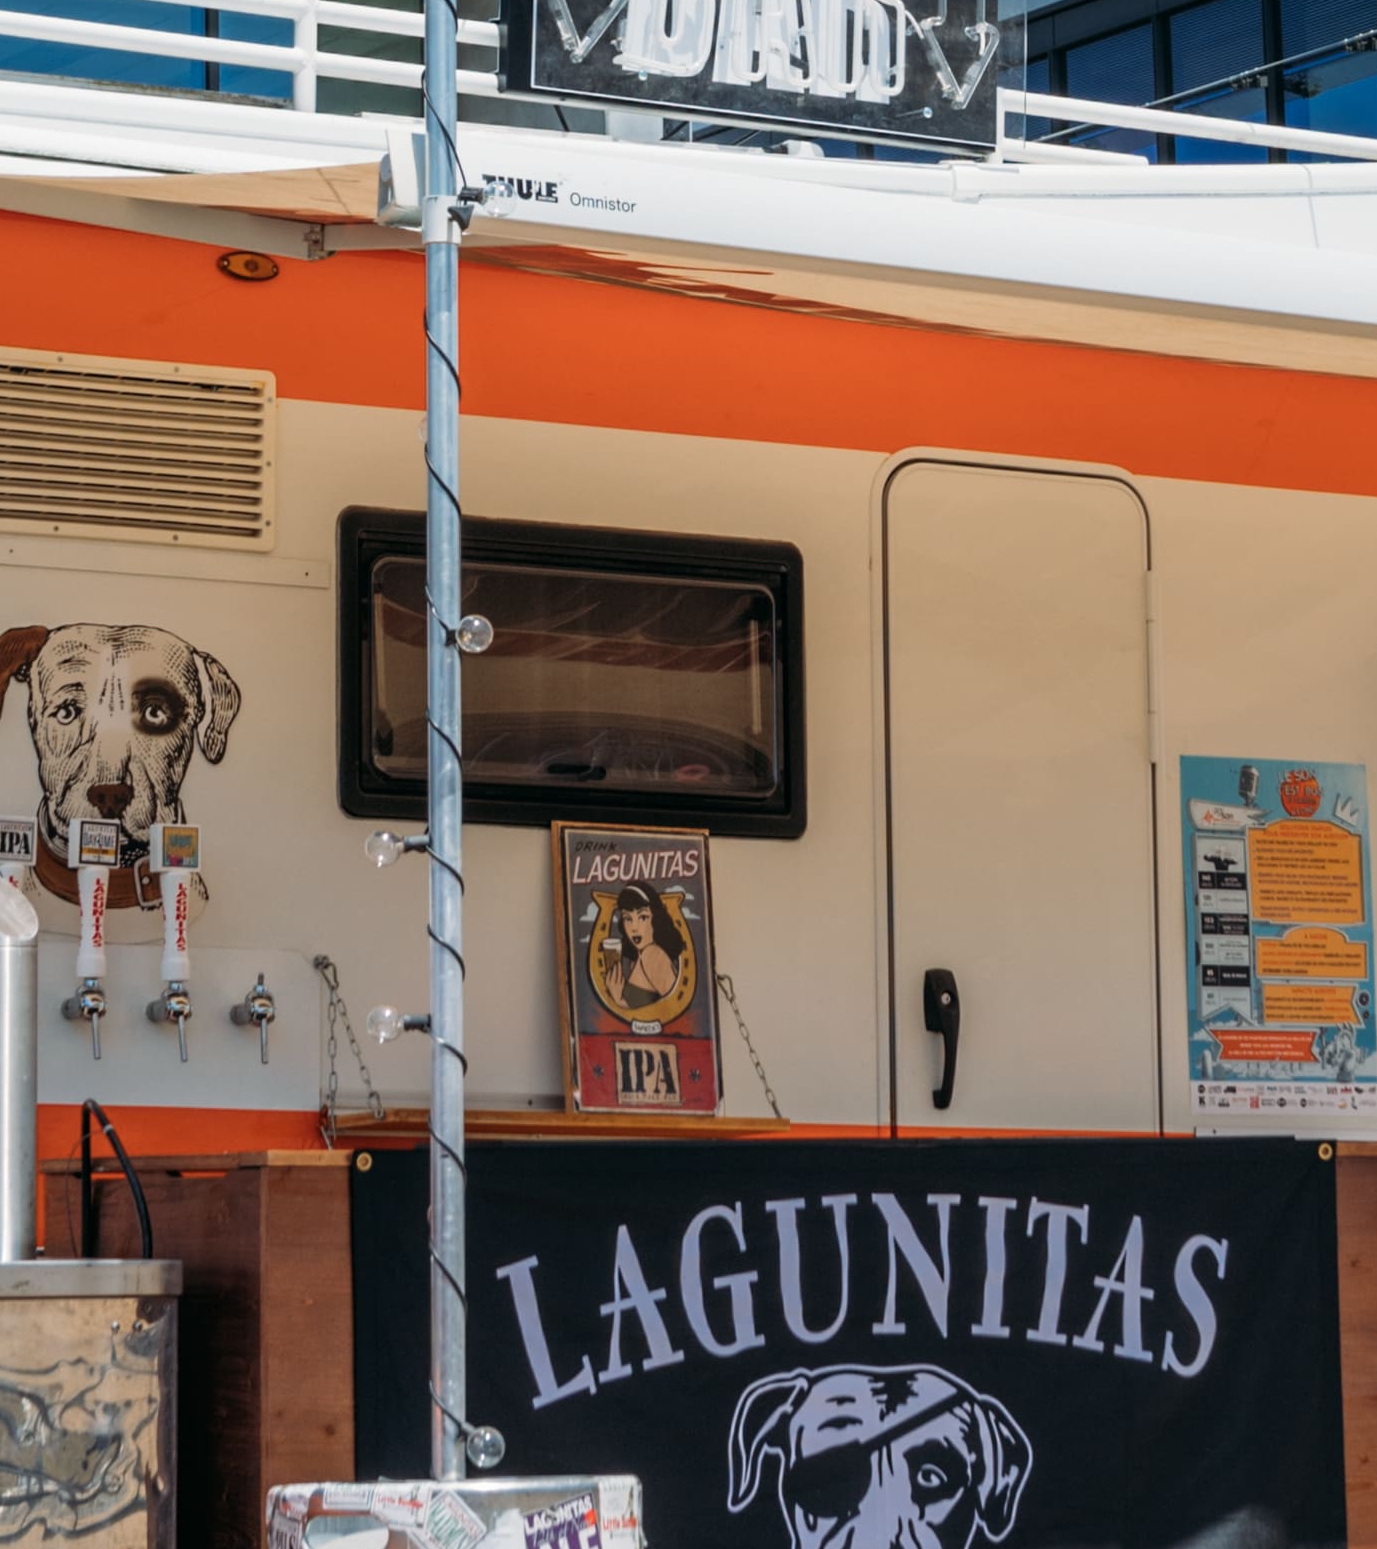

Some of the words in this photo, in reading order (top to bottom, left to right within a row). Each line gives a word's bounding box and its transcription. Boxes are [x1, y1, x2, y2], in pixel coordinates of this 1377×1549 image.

[482, 174, 558, 203] THULE
[570, 192, 637, 213] Omnistor
[0, 831, 31, 855] IPA
[575, 841, 618, 853] DRINK
[573, 850, 699, 884] LAGUNITAS
[92, 878, 106, 947] LAGUNITAS
[176, 883, 188, 952] LAGUNITAS
[620, 1049, 678, 1095] IPA
[496, 1193, 1228, 1410] LAGUNITAS
